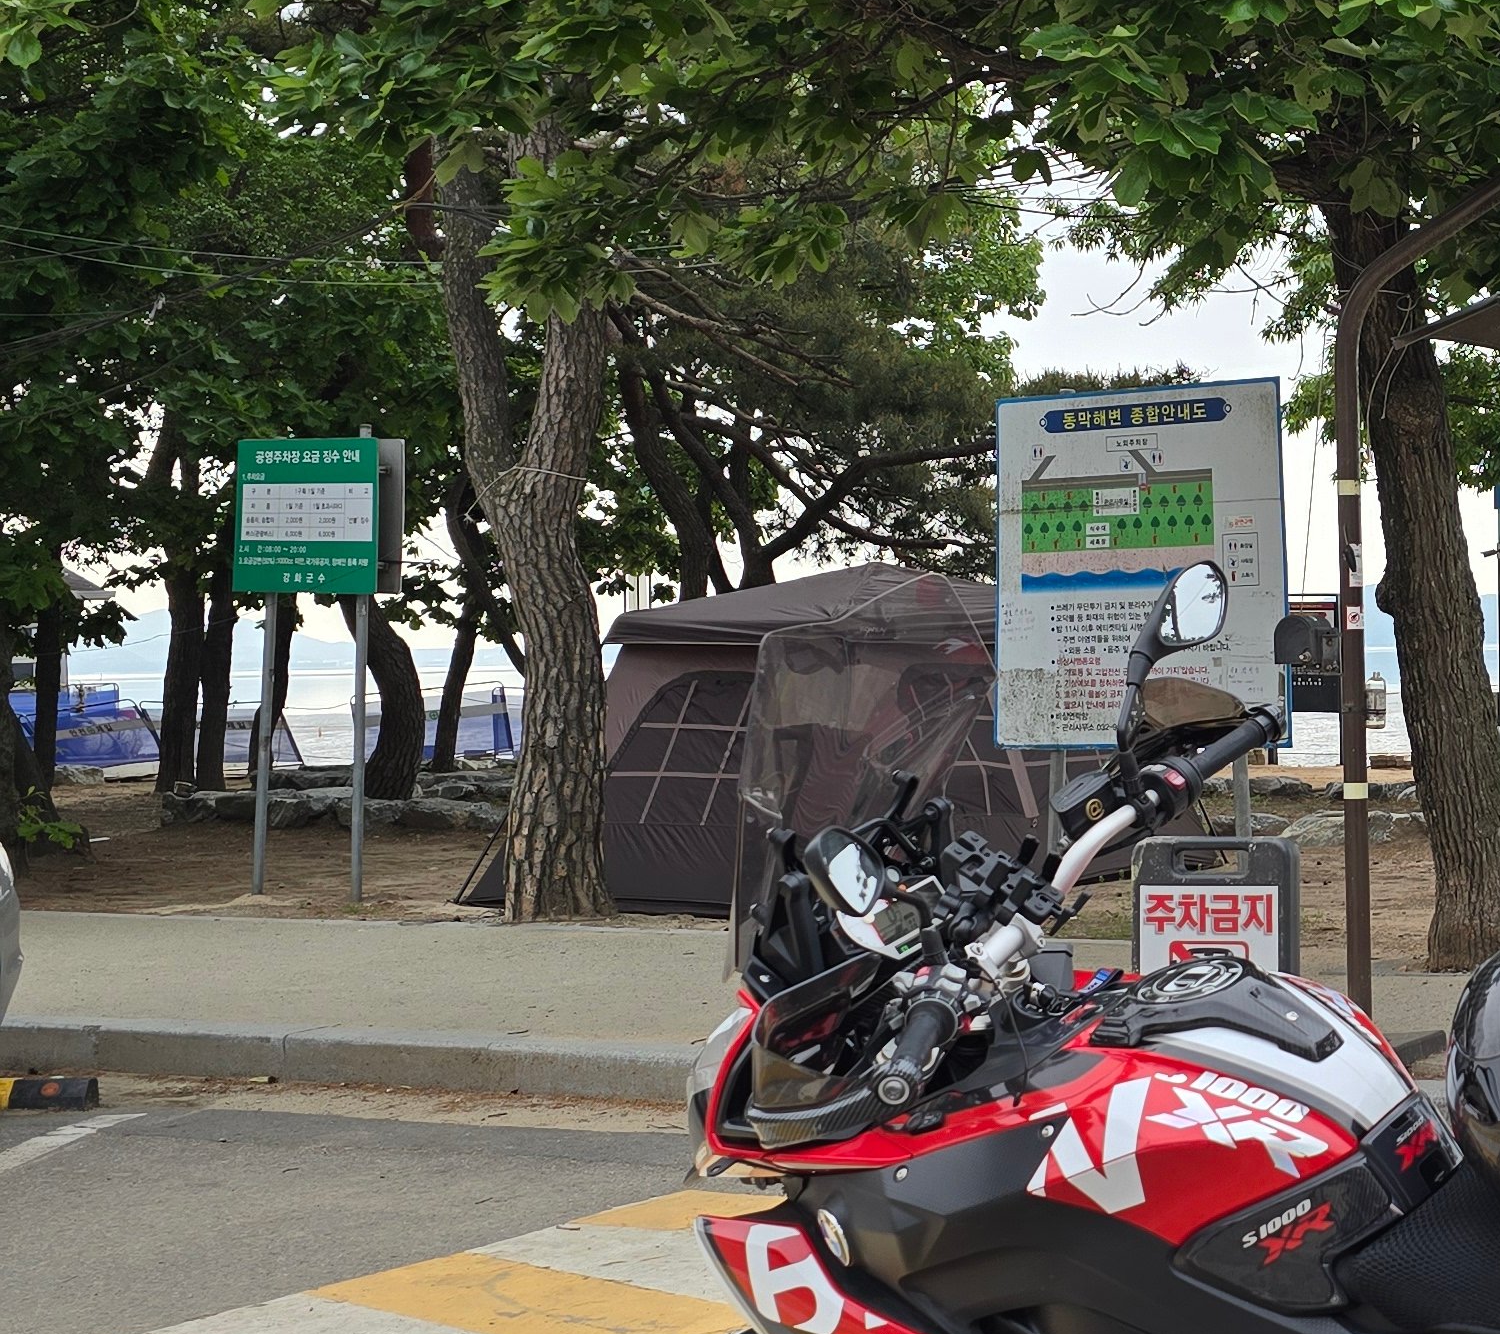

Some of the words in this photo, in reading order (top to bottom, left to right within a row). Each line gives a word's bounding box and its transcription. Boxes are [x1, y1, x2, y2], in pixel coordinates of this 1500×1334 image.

[1063, 408, 1122, 430] 동막해변
[1130, 402, 1207, 425] 종합안내도
[255, 451, 301, 464] 공영주차장
[302, 450, 320, 463] 요금
[322, 449, 340, 463] 징수
[342, 449, 360, 463] 안내
[1127, 600, 1158, 610] 분리수거
[1143, 893, 1274, 936] 주차금지
[1258, 1200, 1335, 1266] XR
